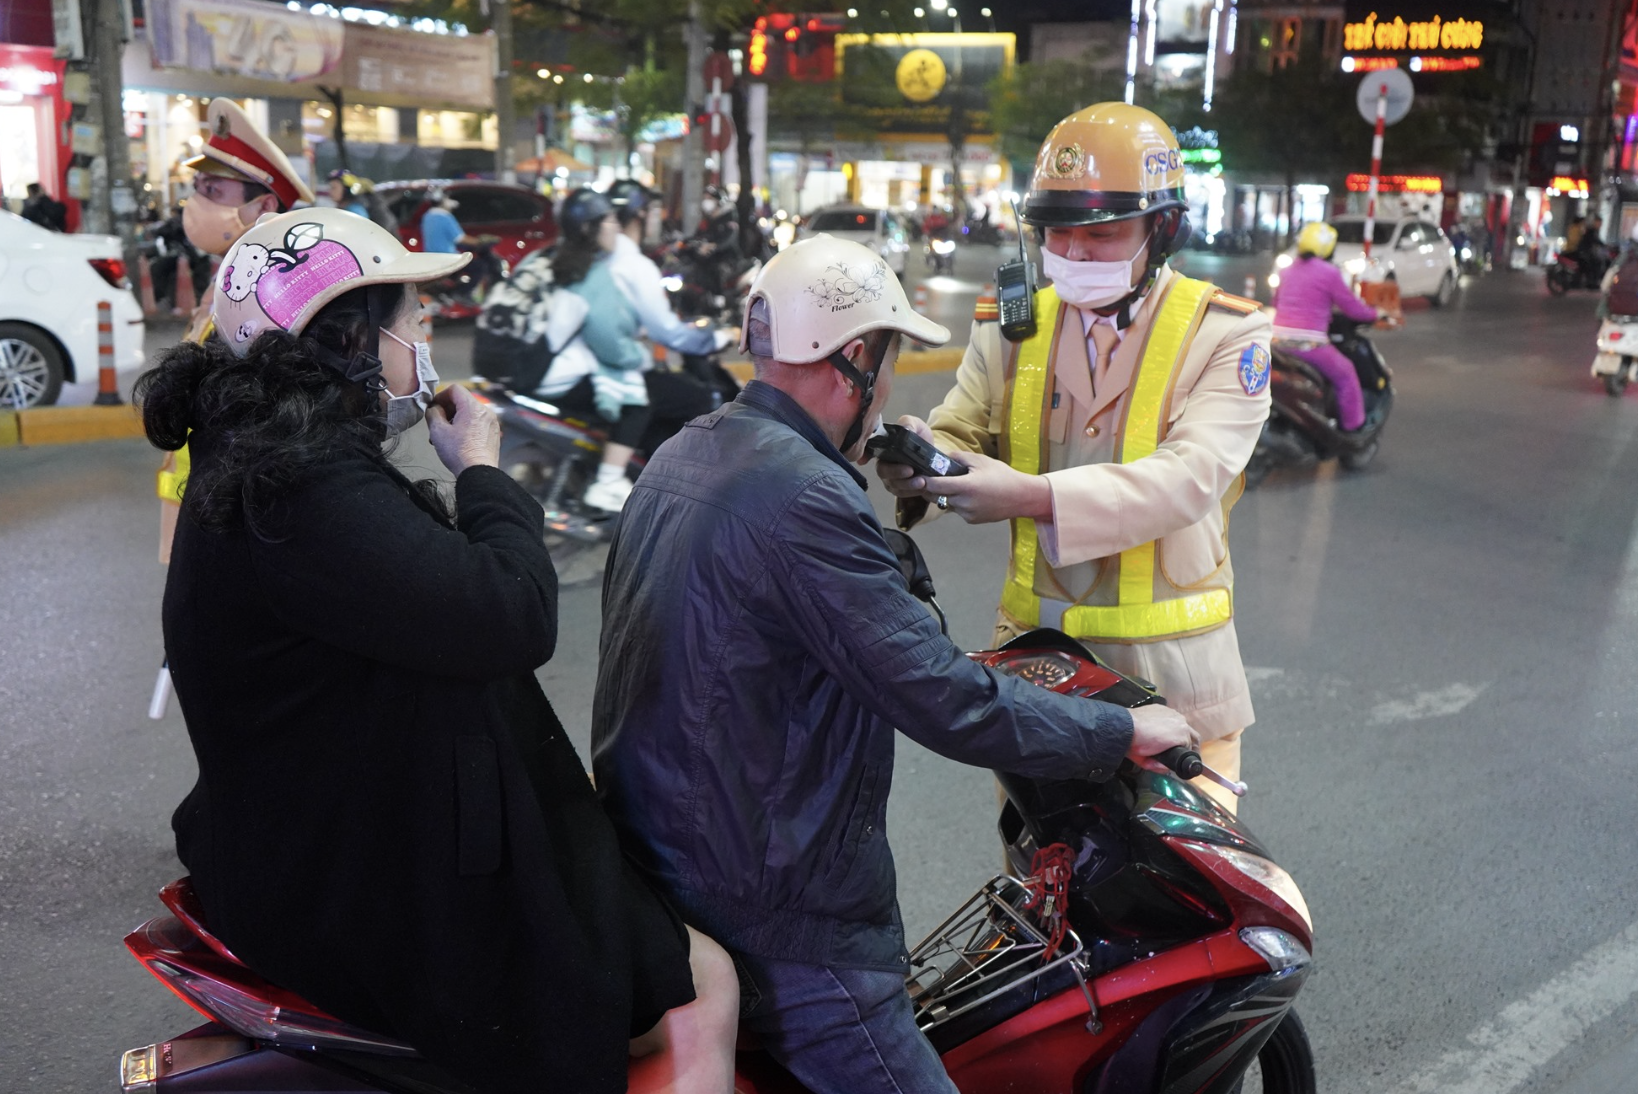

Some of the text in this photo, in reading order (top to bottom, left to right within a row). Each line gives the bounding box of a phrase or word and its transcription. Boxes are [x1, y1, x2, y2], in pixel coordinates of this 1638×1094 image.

[310, 250, 345, 271] HELLO KITTY
[290, 270, 309, 286] KITTY
[831, 303, 855, 313] Flower
